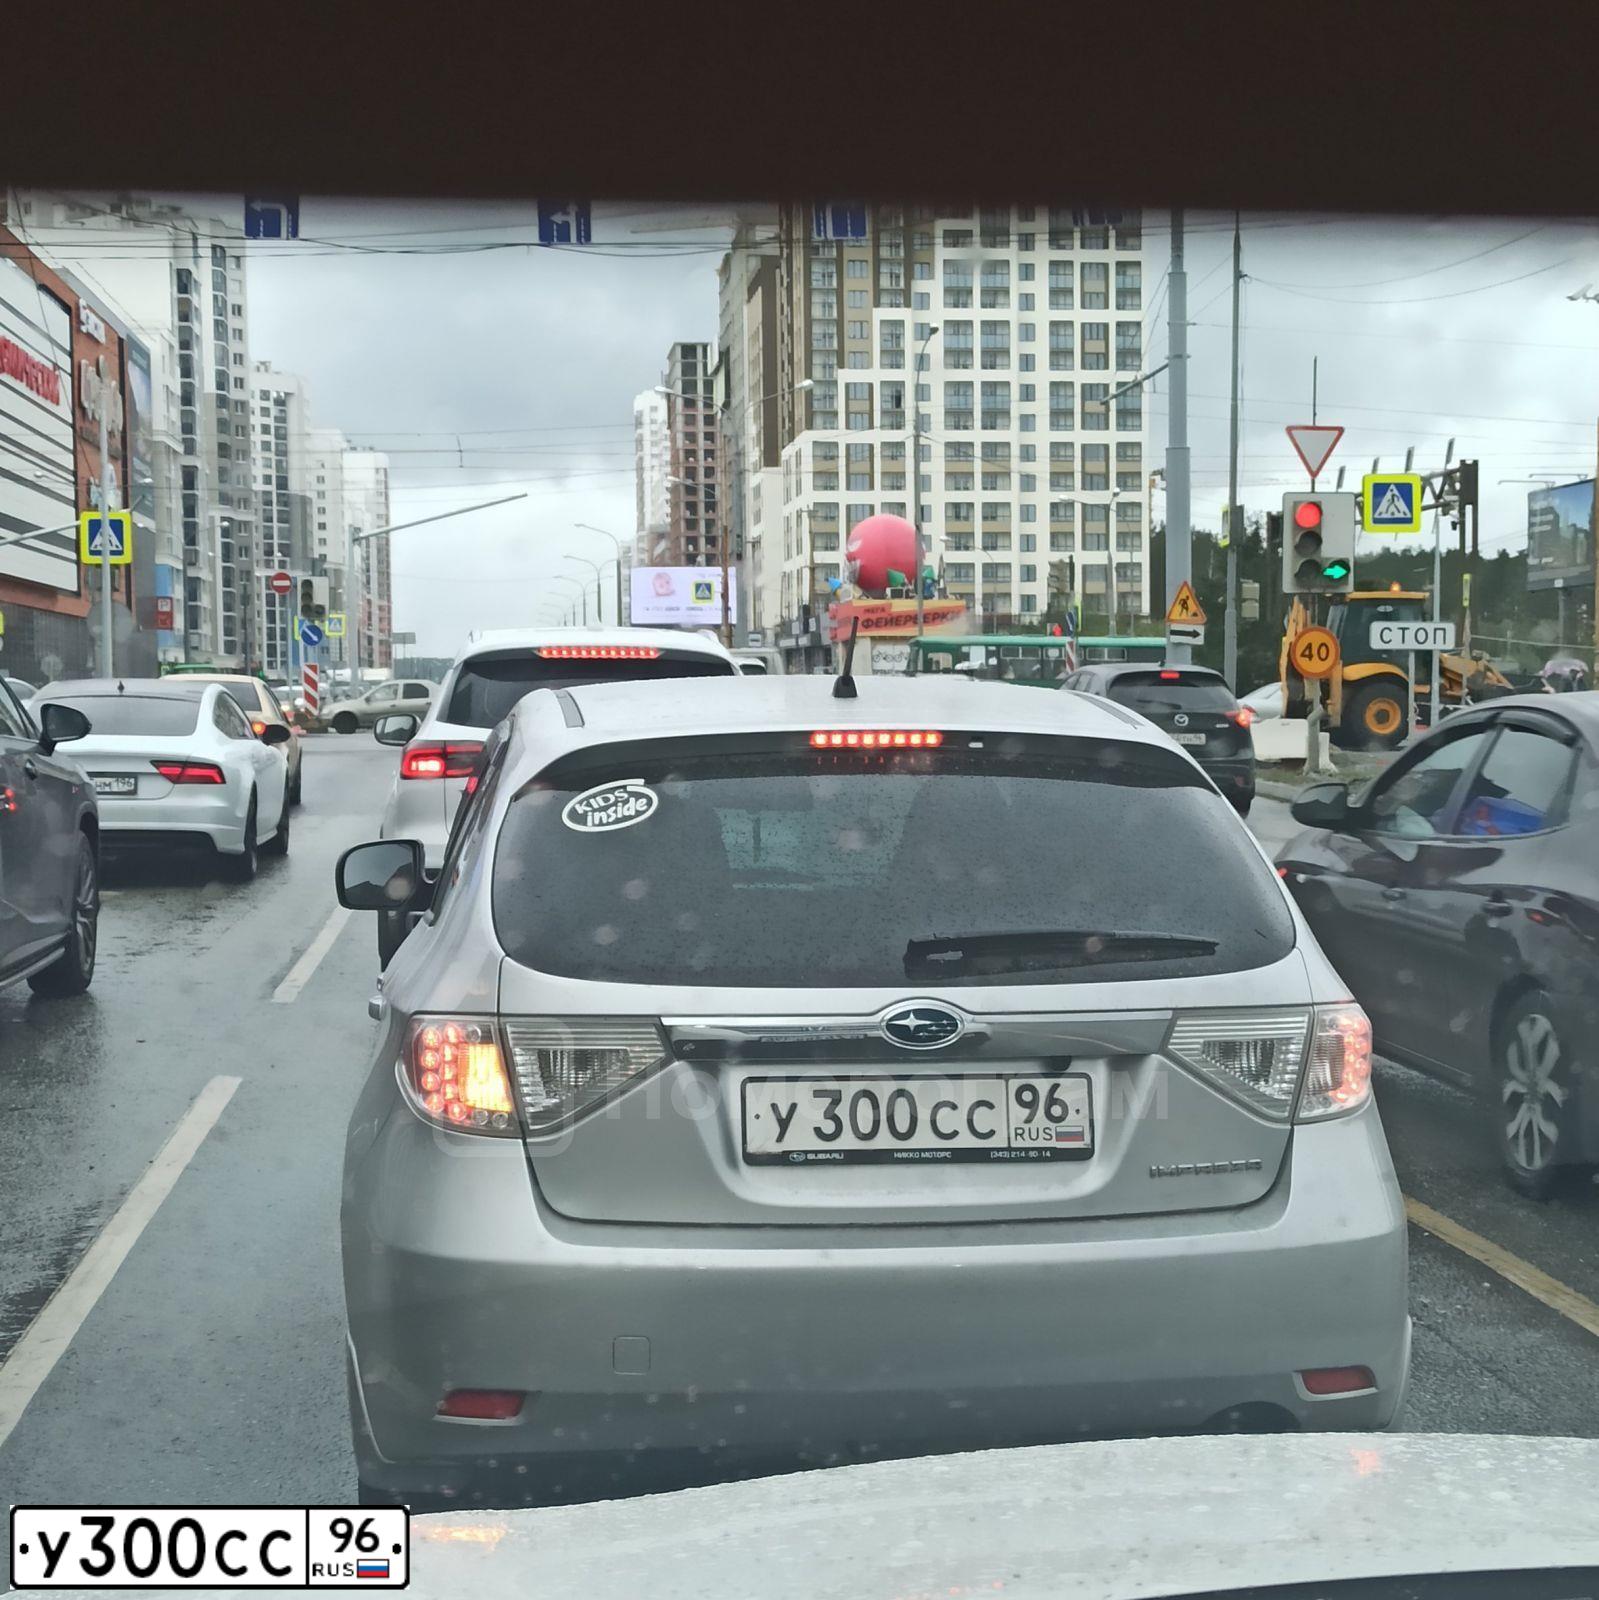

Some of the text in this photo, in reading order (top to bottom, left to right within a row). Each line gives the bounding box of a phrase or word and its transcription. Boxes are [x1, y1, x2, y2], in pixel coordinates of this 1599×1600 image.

[1379, 626, 1447, 645] СТОП
[1300, 642, 1330, 662] 40
[574, 788, 629, 815] KIDS
[586, 797, 648, 827] inside
[1014, 1082, 1070, 1125] 96
[1014, 1126, 1054, 1142] RUS
[806, 1152, 845, 1161] SUBARU
